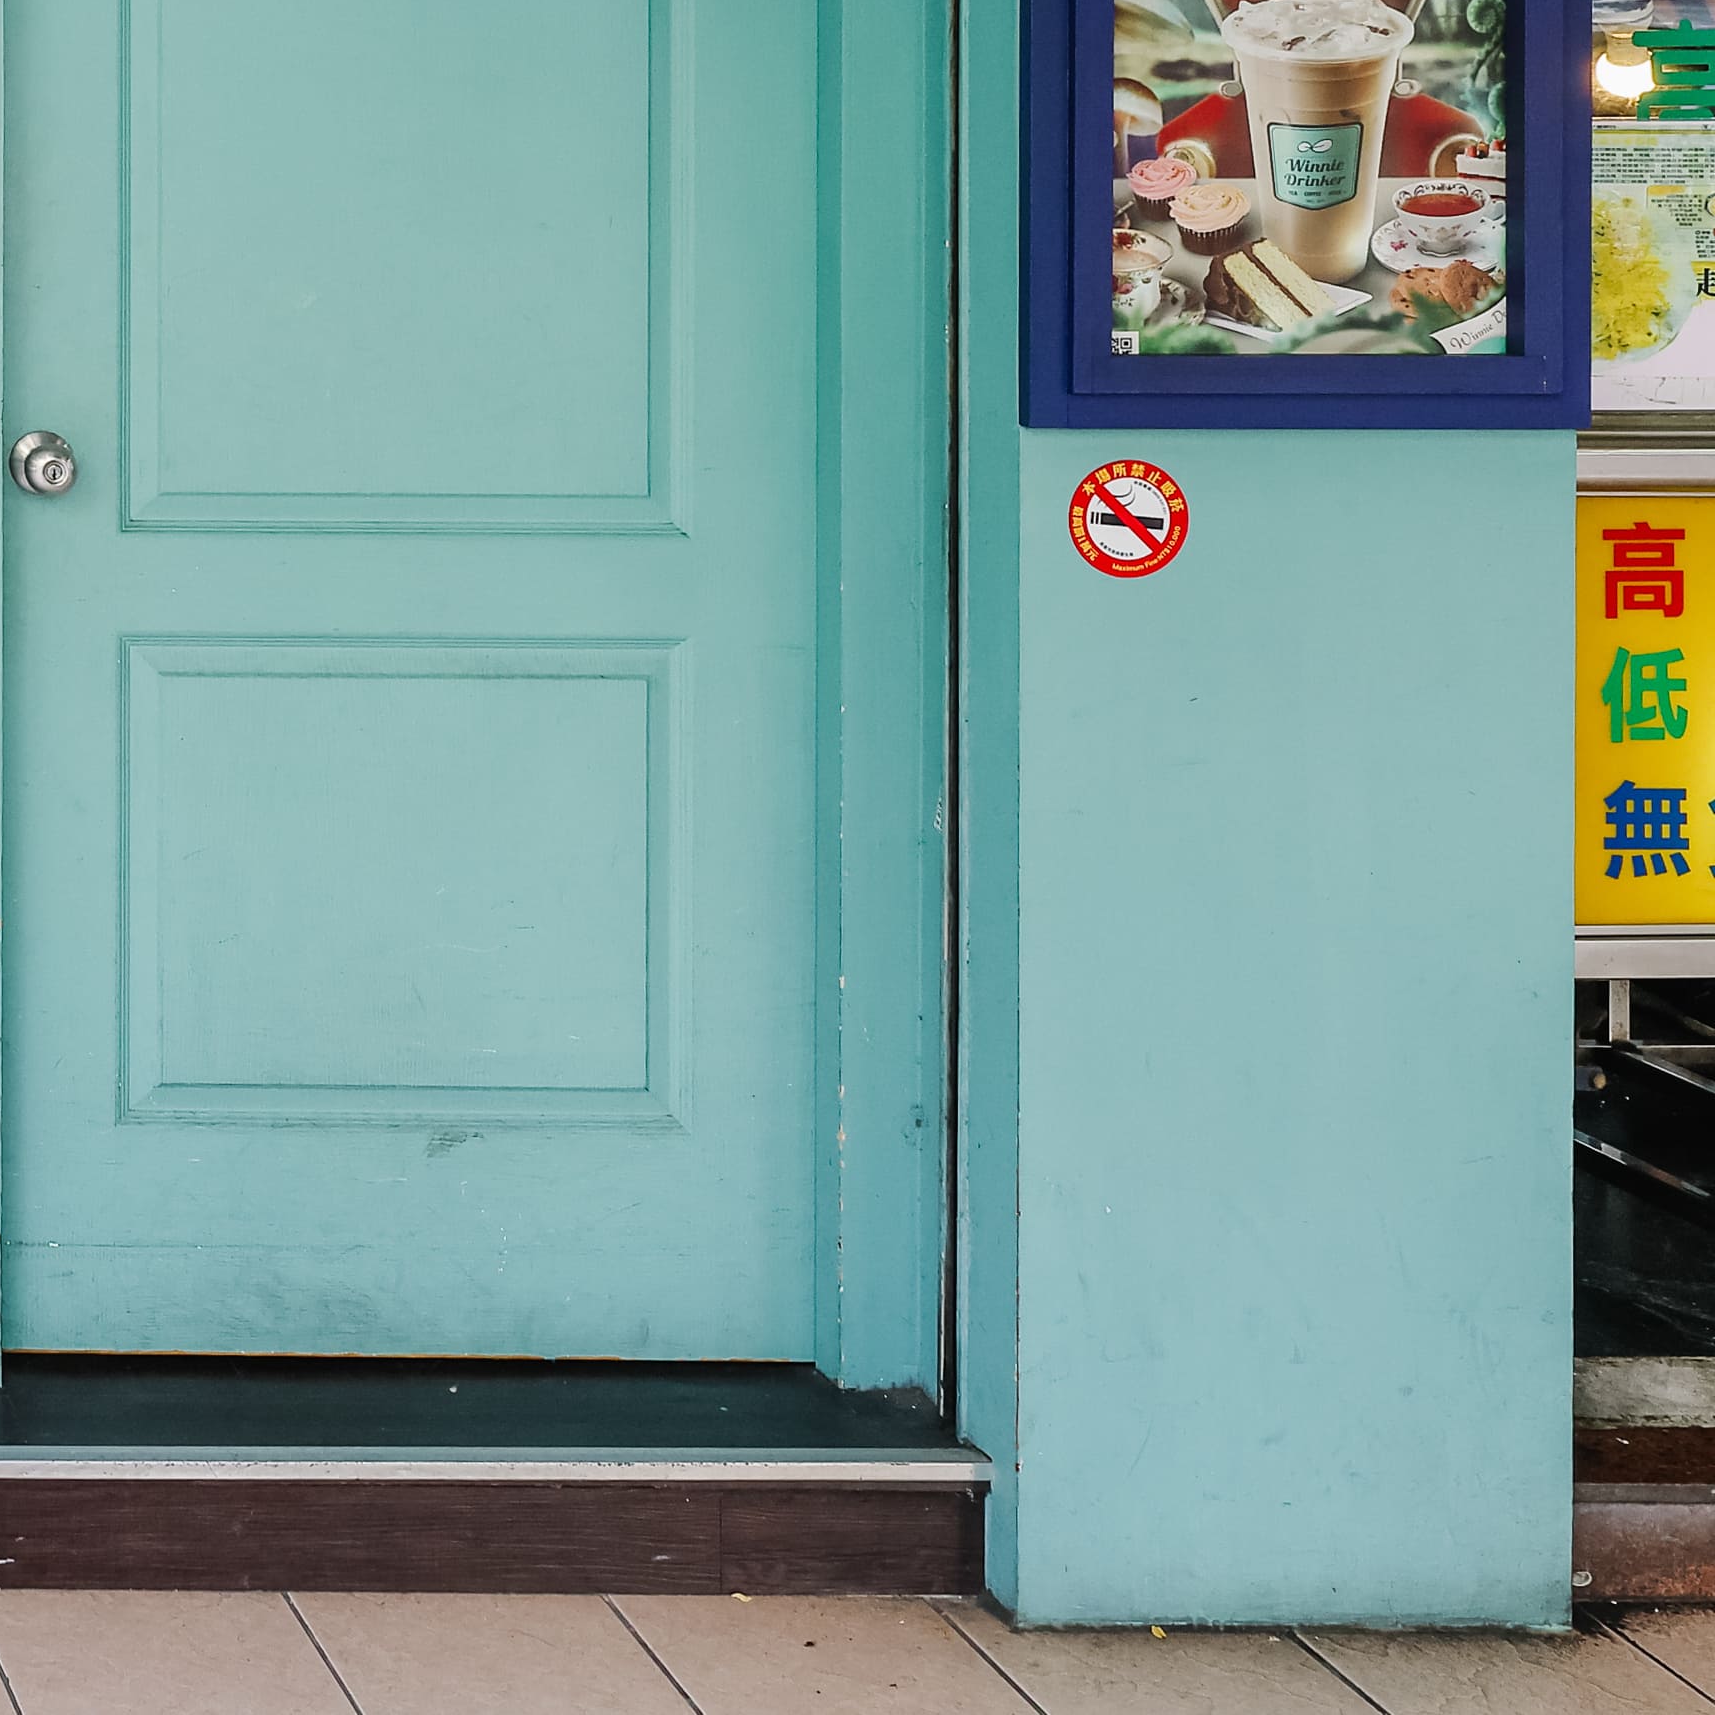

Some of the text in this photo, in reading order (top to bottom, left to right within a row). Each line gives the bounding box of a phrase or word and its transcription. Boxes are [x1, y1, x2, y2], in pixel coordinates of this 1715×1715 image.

[1285, 159, 1346, 173] Winnie
[1284, 173, 1346, 187] Drinker
[1449, 323, 1494, 349] Winnie
[1602, 521, 1686, 619] 高
[1601, 646, 1689, 744] 低
